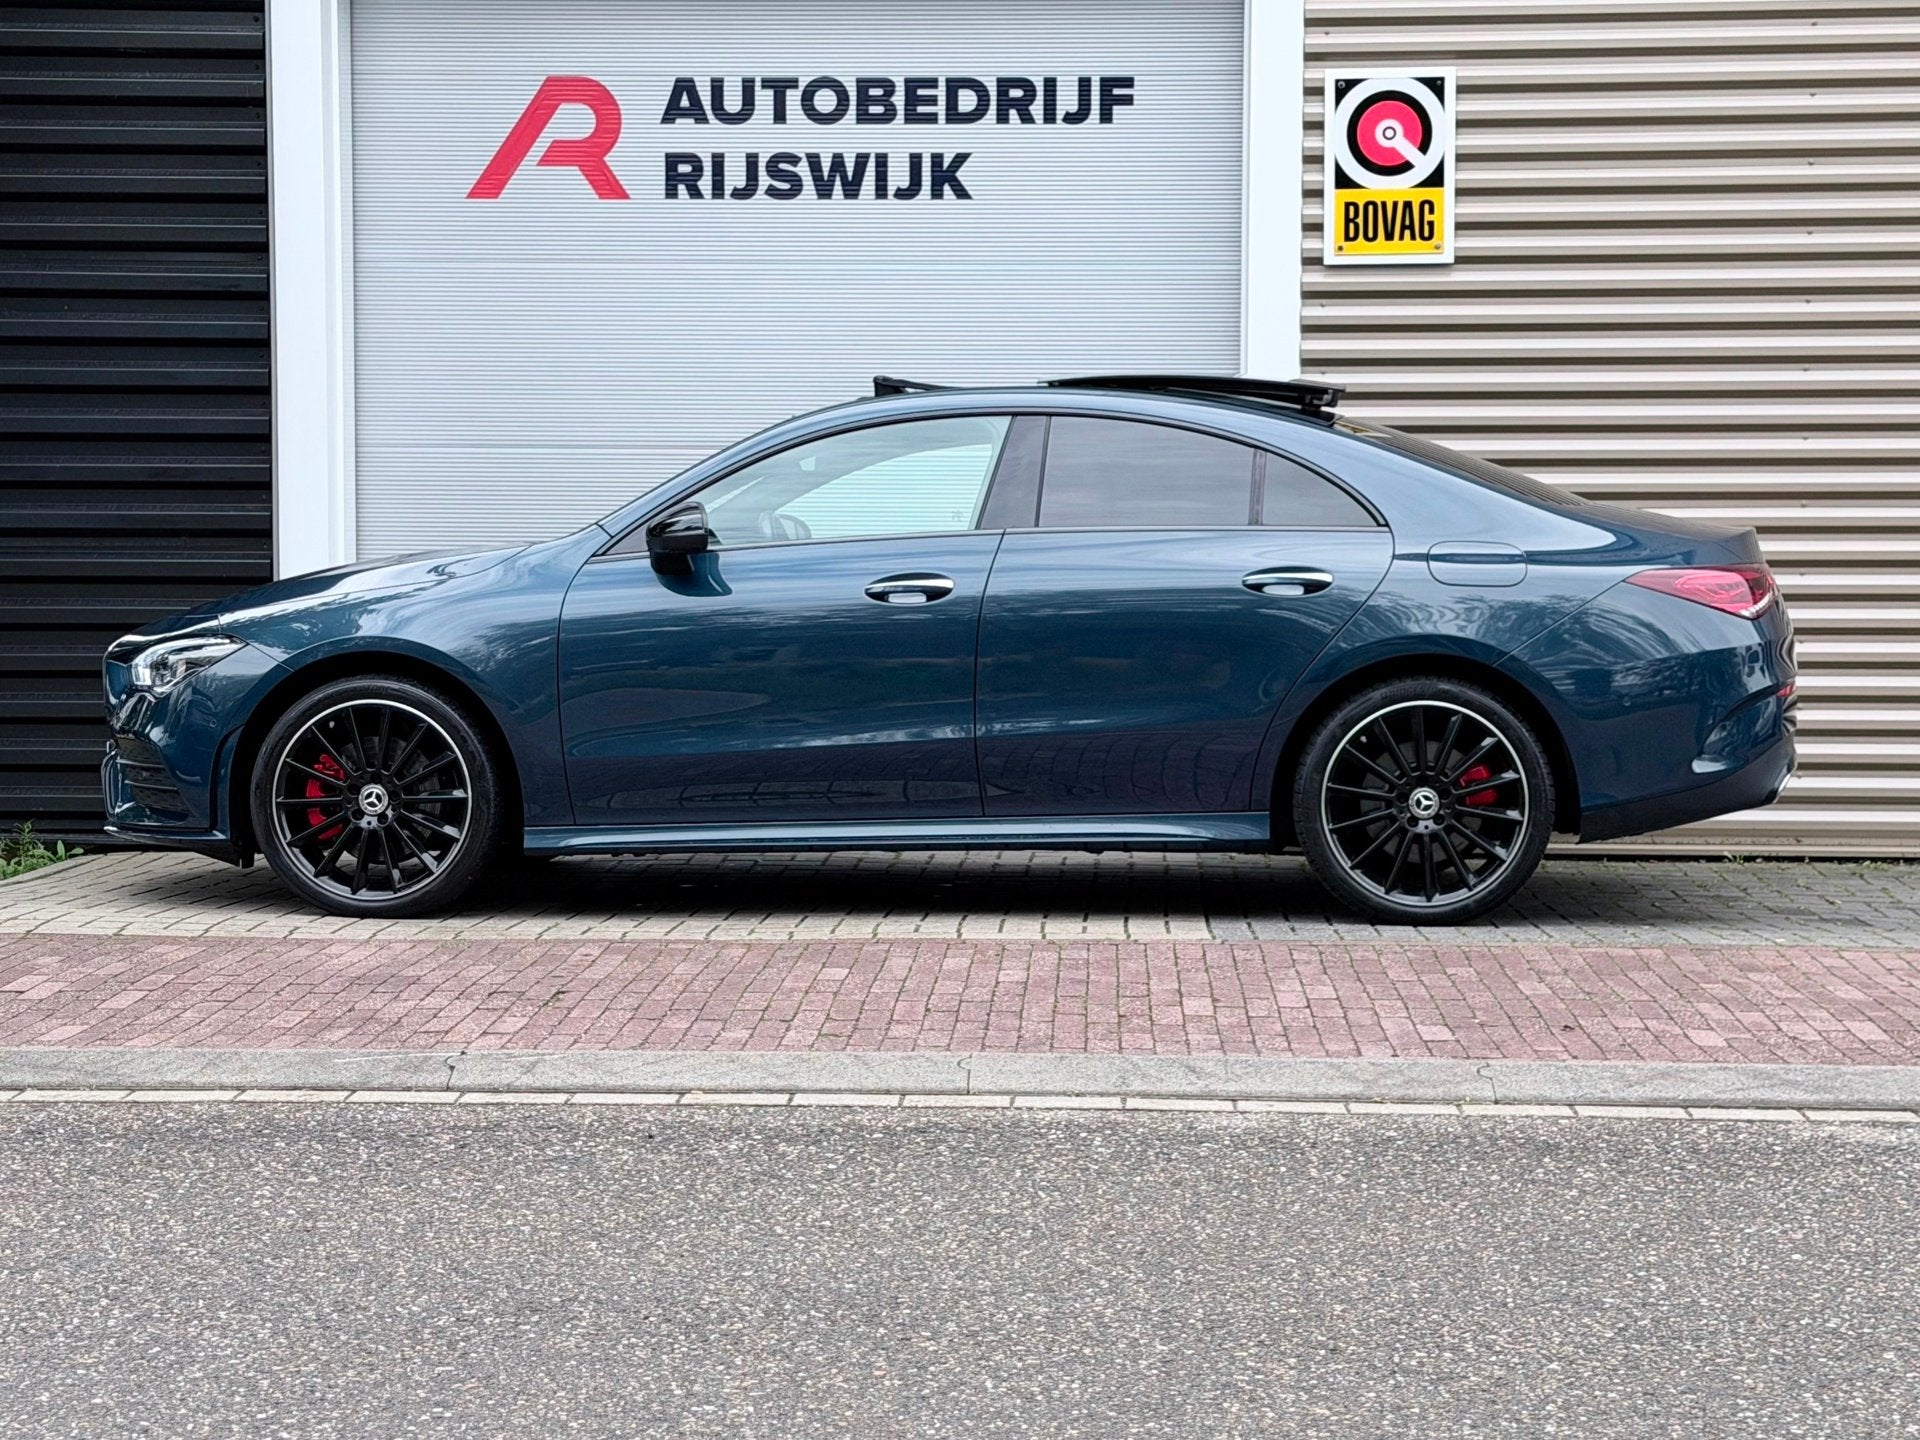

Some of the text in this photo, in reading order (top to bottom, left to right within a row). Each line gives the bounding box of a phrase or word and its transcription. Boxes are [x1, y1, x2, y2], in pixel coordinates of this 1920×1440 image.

[661, 76, 1135, 125] AUTOBEDRIJF
[664, 152, 973, 200] RIJSWIJK
[1344, 199, 1435, 242] BOVAG
